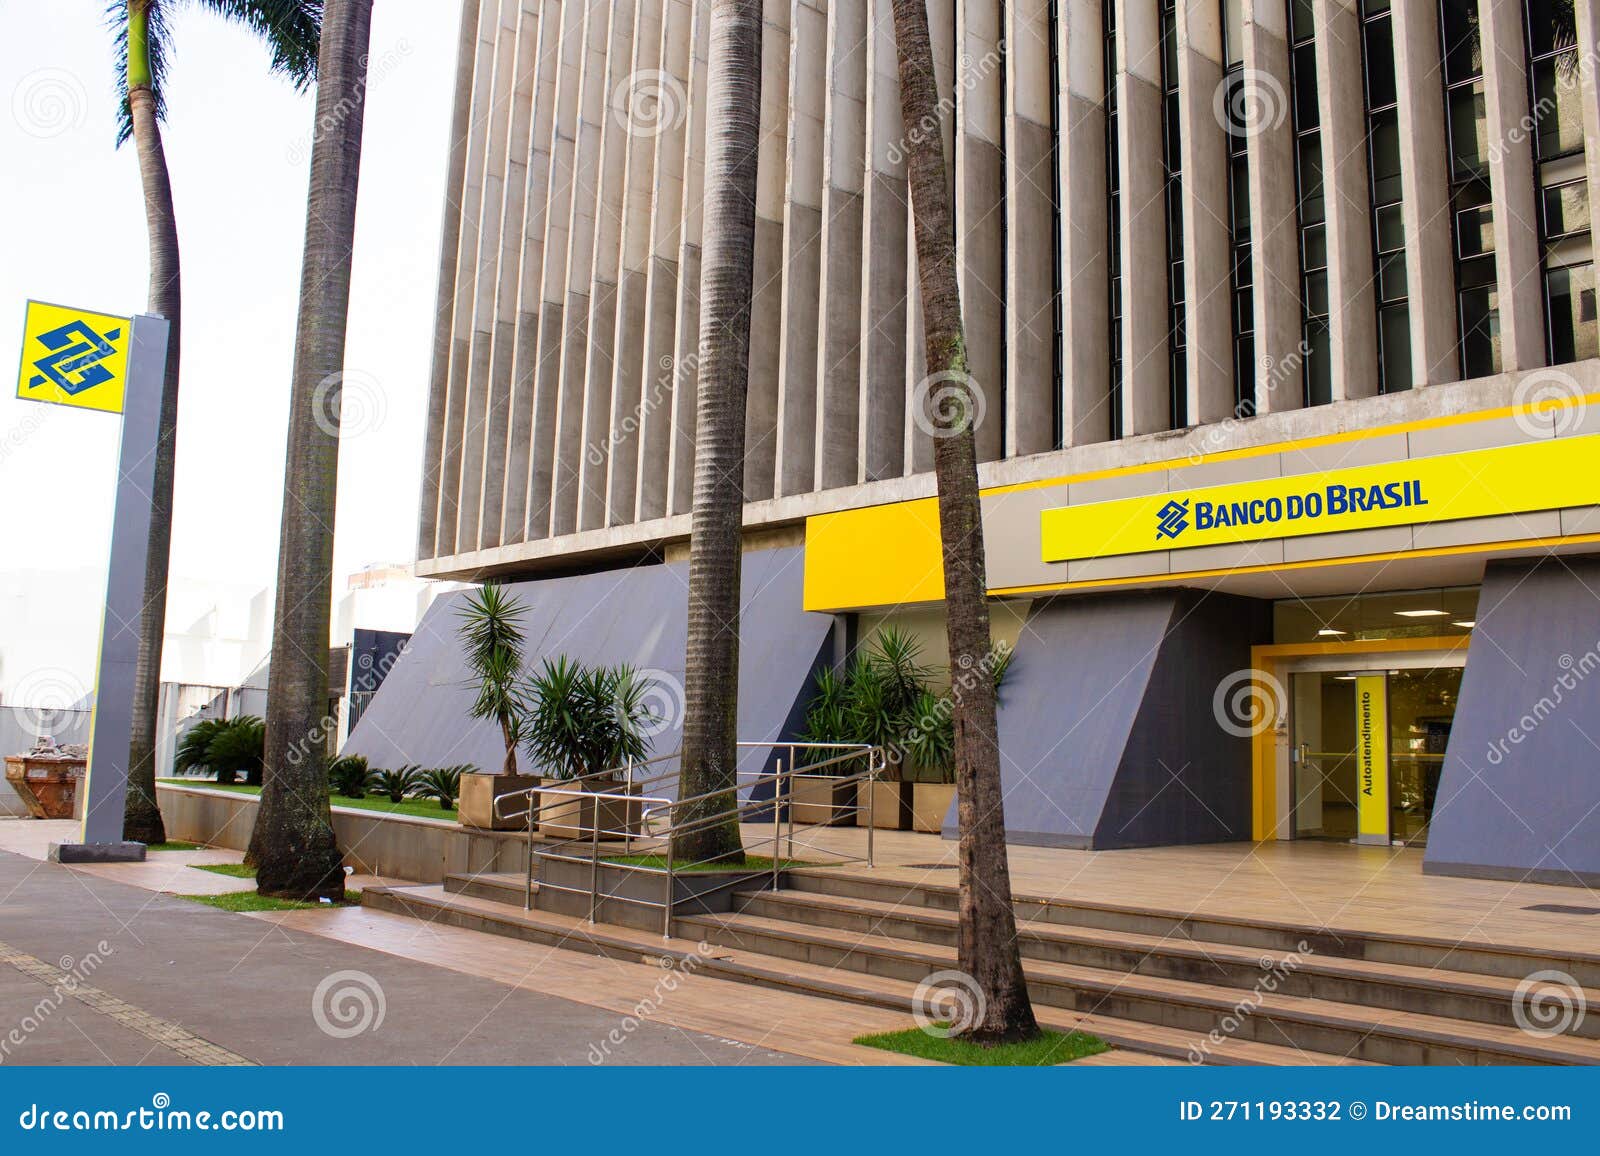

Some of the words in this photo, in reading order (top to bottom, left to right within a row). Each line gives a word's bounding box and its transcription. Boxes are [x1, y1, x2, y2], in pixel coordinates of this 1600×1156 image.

[1195, 497, 1283, 531] BANCO
[1287, 492, 1323, 520] DO
[1326, 479, 1429, 516] BRASIL
[1362, 691, 1373, 796] Autoatendimento
